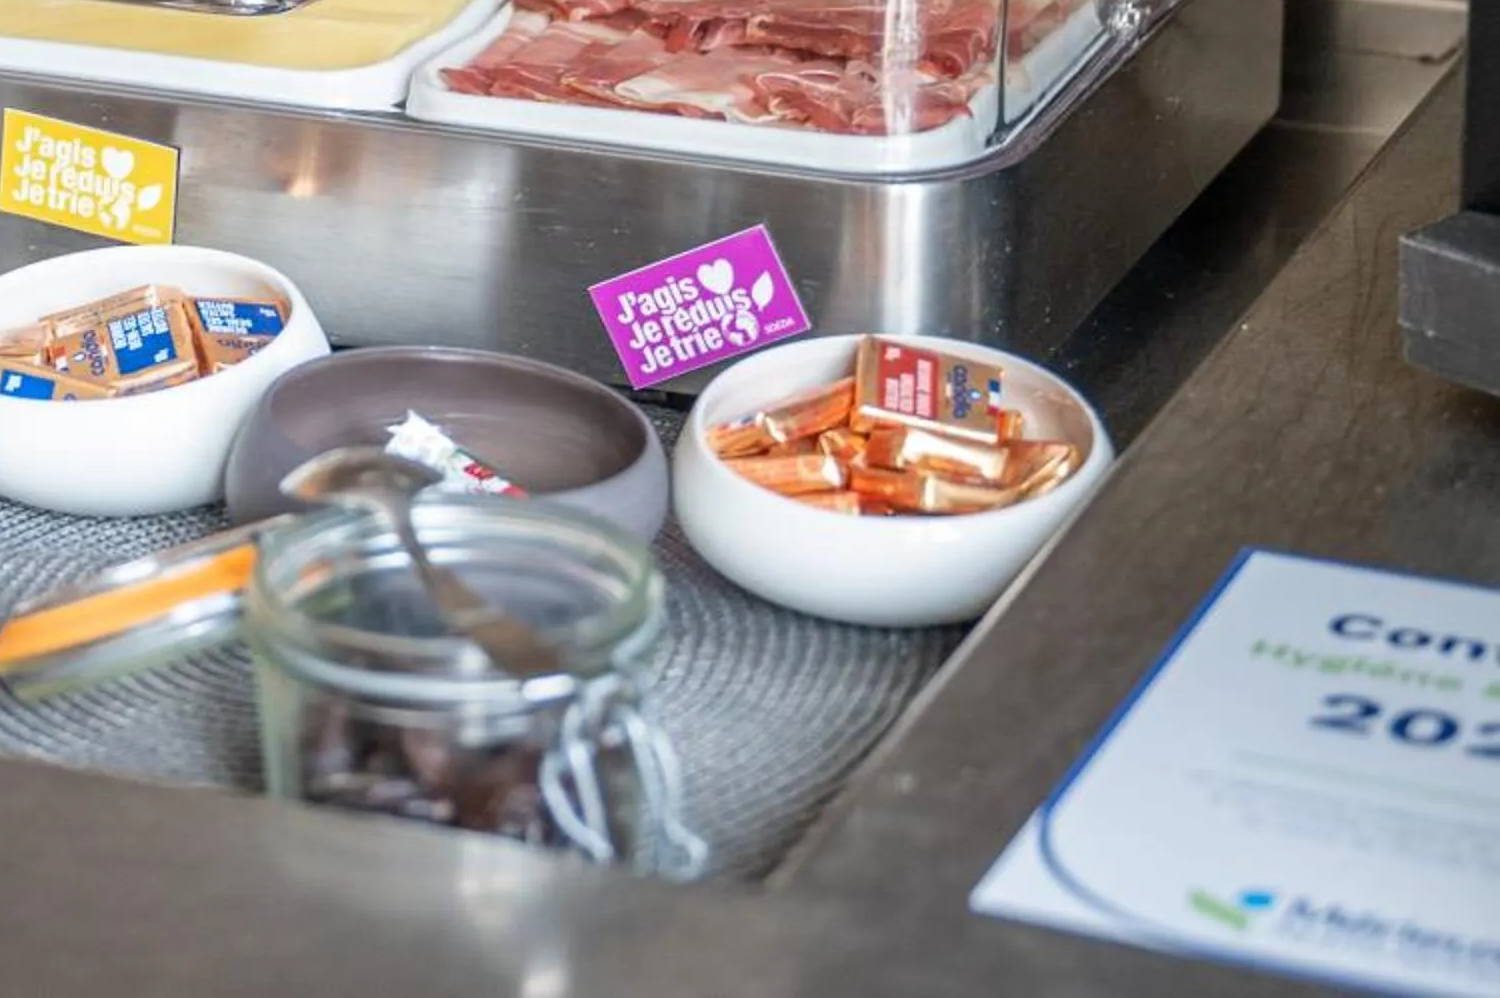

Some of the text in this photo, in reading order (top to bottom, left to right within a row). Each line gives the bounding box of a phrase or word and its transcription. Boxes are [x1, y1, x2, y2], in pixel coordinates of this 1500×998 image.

[13, 153, 47, 182] Je
[15, 125, 96, 168] J'agis
[12, 179, 97, 219] Je trie
[617, 276, 700, 325] J'agis
[629, 287, 752, 350] Je réduis
[640, 325, 725, 374] Je trie
[1328, 612, 1500, 666] Con
